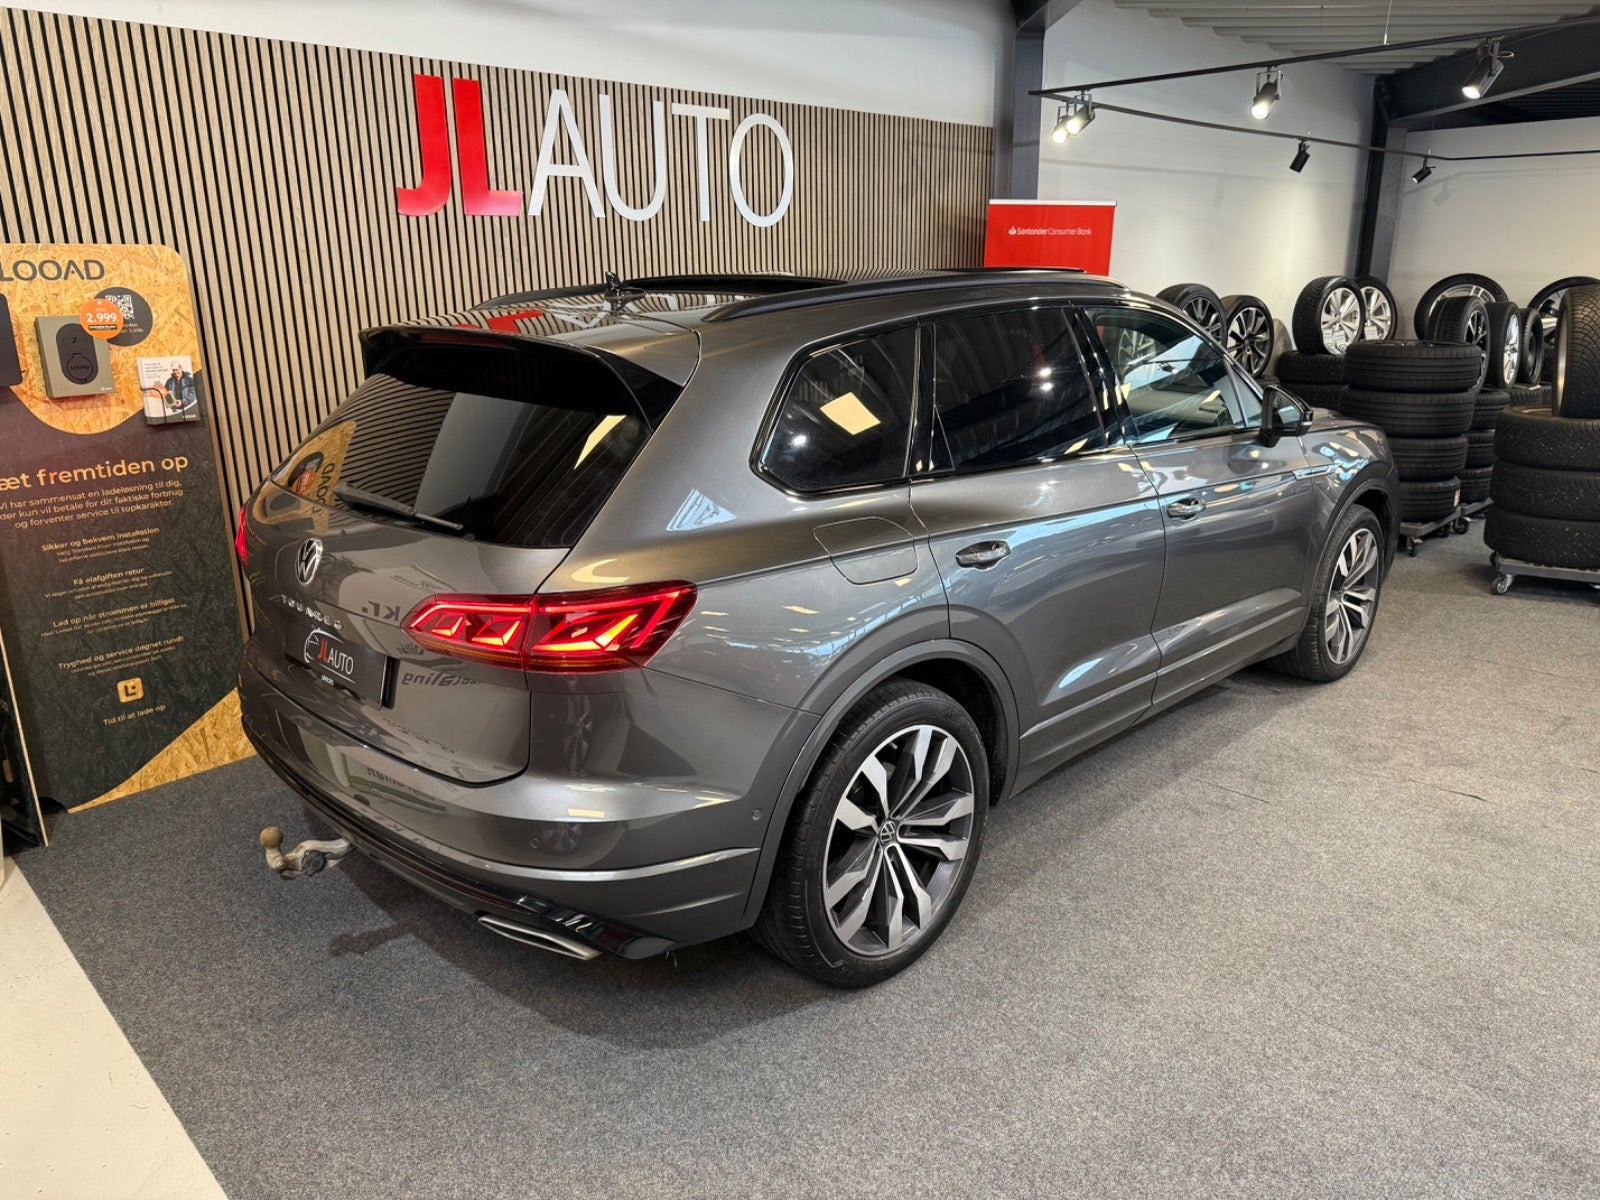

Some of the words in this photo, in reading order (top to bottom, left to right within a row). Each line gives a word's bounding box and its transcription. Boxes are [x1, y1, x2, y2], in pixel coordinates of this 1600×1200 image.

[1017, 227, 1048, 235] Santander
[1048, 227, 1076, 236] Consumer
[1077, 227, 1092, 236] Bank
[0, 259, 105, 282] LOOAD
[86, 312, 117, 323] 2.999
[37, 459, 155, 486] fremtiden
[161, 456, 189, 472] op
[0, 511, 17, 521] der
[18, 508, 39, 519] kun
[40, 506, 52, 515] vil
[53, 502, 84, 513] betale
[85, 499, 98, 509] for
[100, 498, 113, 507] dit
[114, 493, 150, 505] faktiske
[151, 488, 183, 501] forbrug
[10, 498, 27, 509] har
[30, 492, 86, 507] sammensat
[88, 490, 100, 498] en
[155, 480, 164, 489] til
[15, 520, 28, 530] og
[30, 513, 74, 527] forventer
[76, 509, 109, 520] service
[110, 507, 120, 516] til
[327, 647, 354, 675] AUTO
[103, 716, 116, 726] Tid
